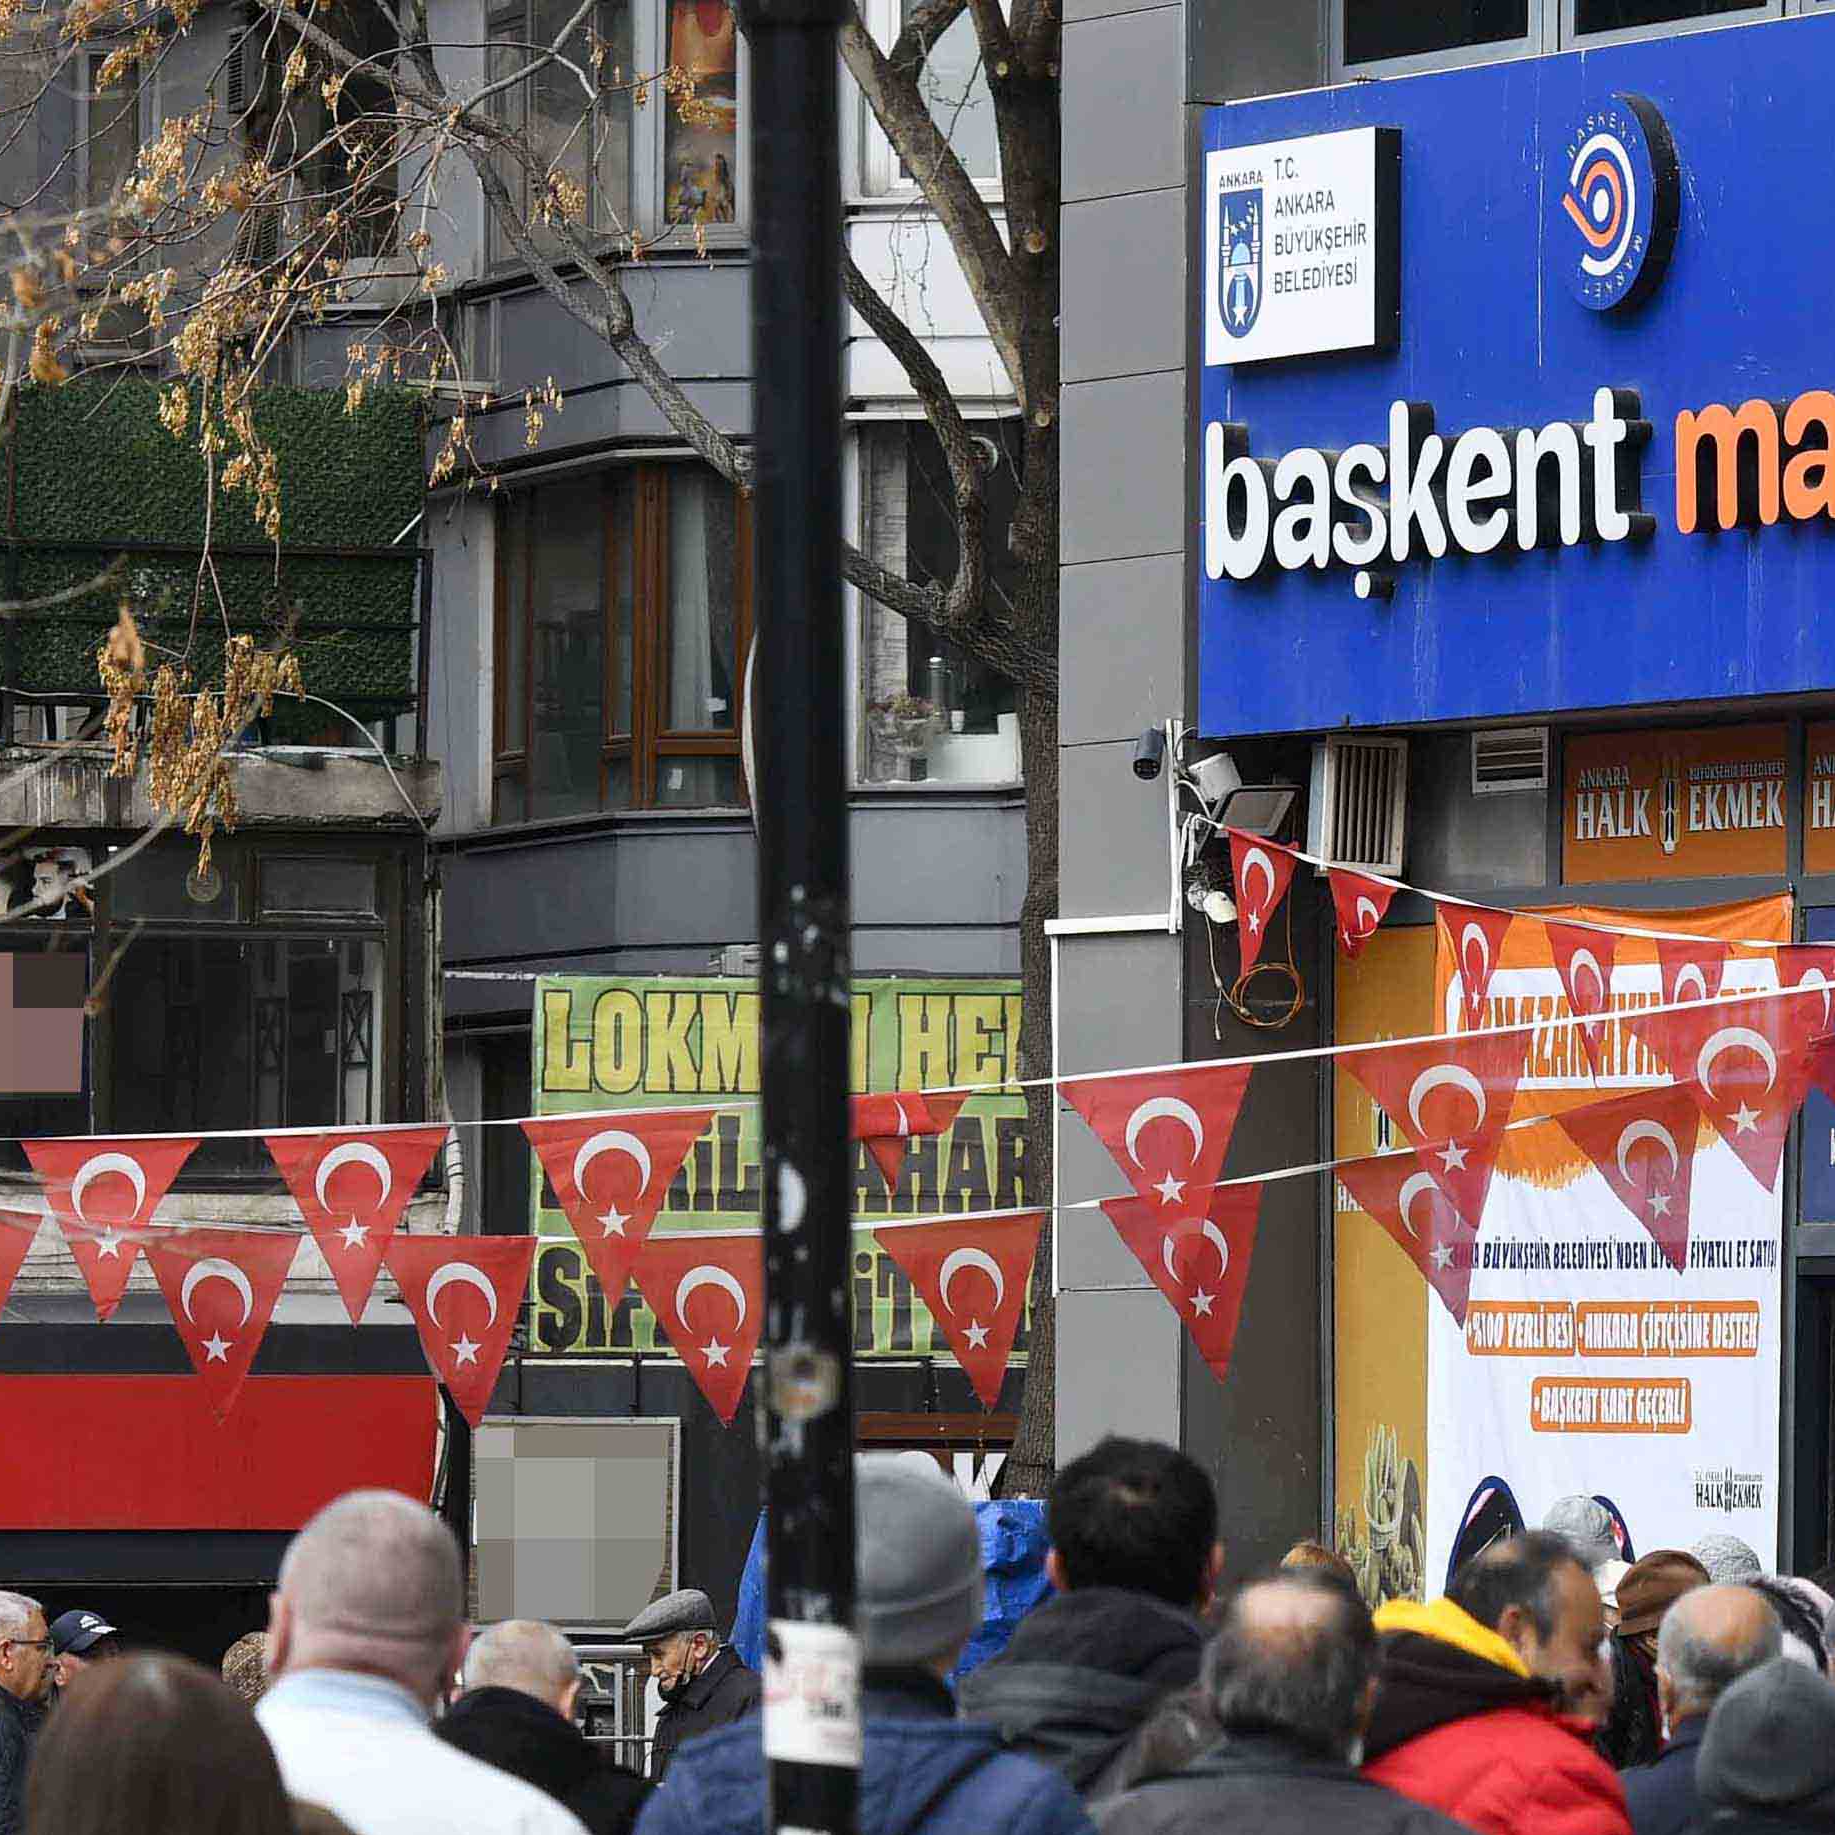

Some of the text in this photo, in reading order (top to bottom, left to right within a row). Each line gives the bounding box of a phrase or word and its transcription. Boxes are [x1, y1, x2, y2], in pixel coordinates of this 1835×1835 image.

[1219, 169, 1264, 190] ANKARA
[1274, 157, 1299, 181] T.C.
[1274, 189, 1335, 218] ANKARA
[1274, 218, 1368, 256] BÜYÜKŞEHİR
[1274, 257, 1358, 294] BELEDİYESİ
[1204, 386, 1632, 599] başkent
[1579, 766, 1630, 789] ANKARA
[1576, 781, 1786, 839] HALK EKMEK
[1483, 1235, 1552, 1276] BÜYÜKŞEHİR
[1690, 1233, 1733, 1269] FİYATLI
[1736, 1240, 1747, 1269] ET
[1749, 1239, 1778, 1273] SATIŞI
[1508, 1304, 1545, 1349] YERLİ
[1585, 1312, 1638, 1350] ANKARA
[1712, 1312, 1759, 1350] DESTEK
[1541, 1386, 1598, 1430] BAŞKENT
[1600, 1387, 1634, 1424] KART
[1695, 1483, 1763, 1508] HALK EKMEK
